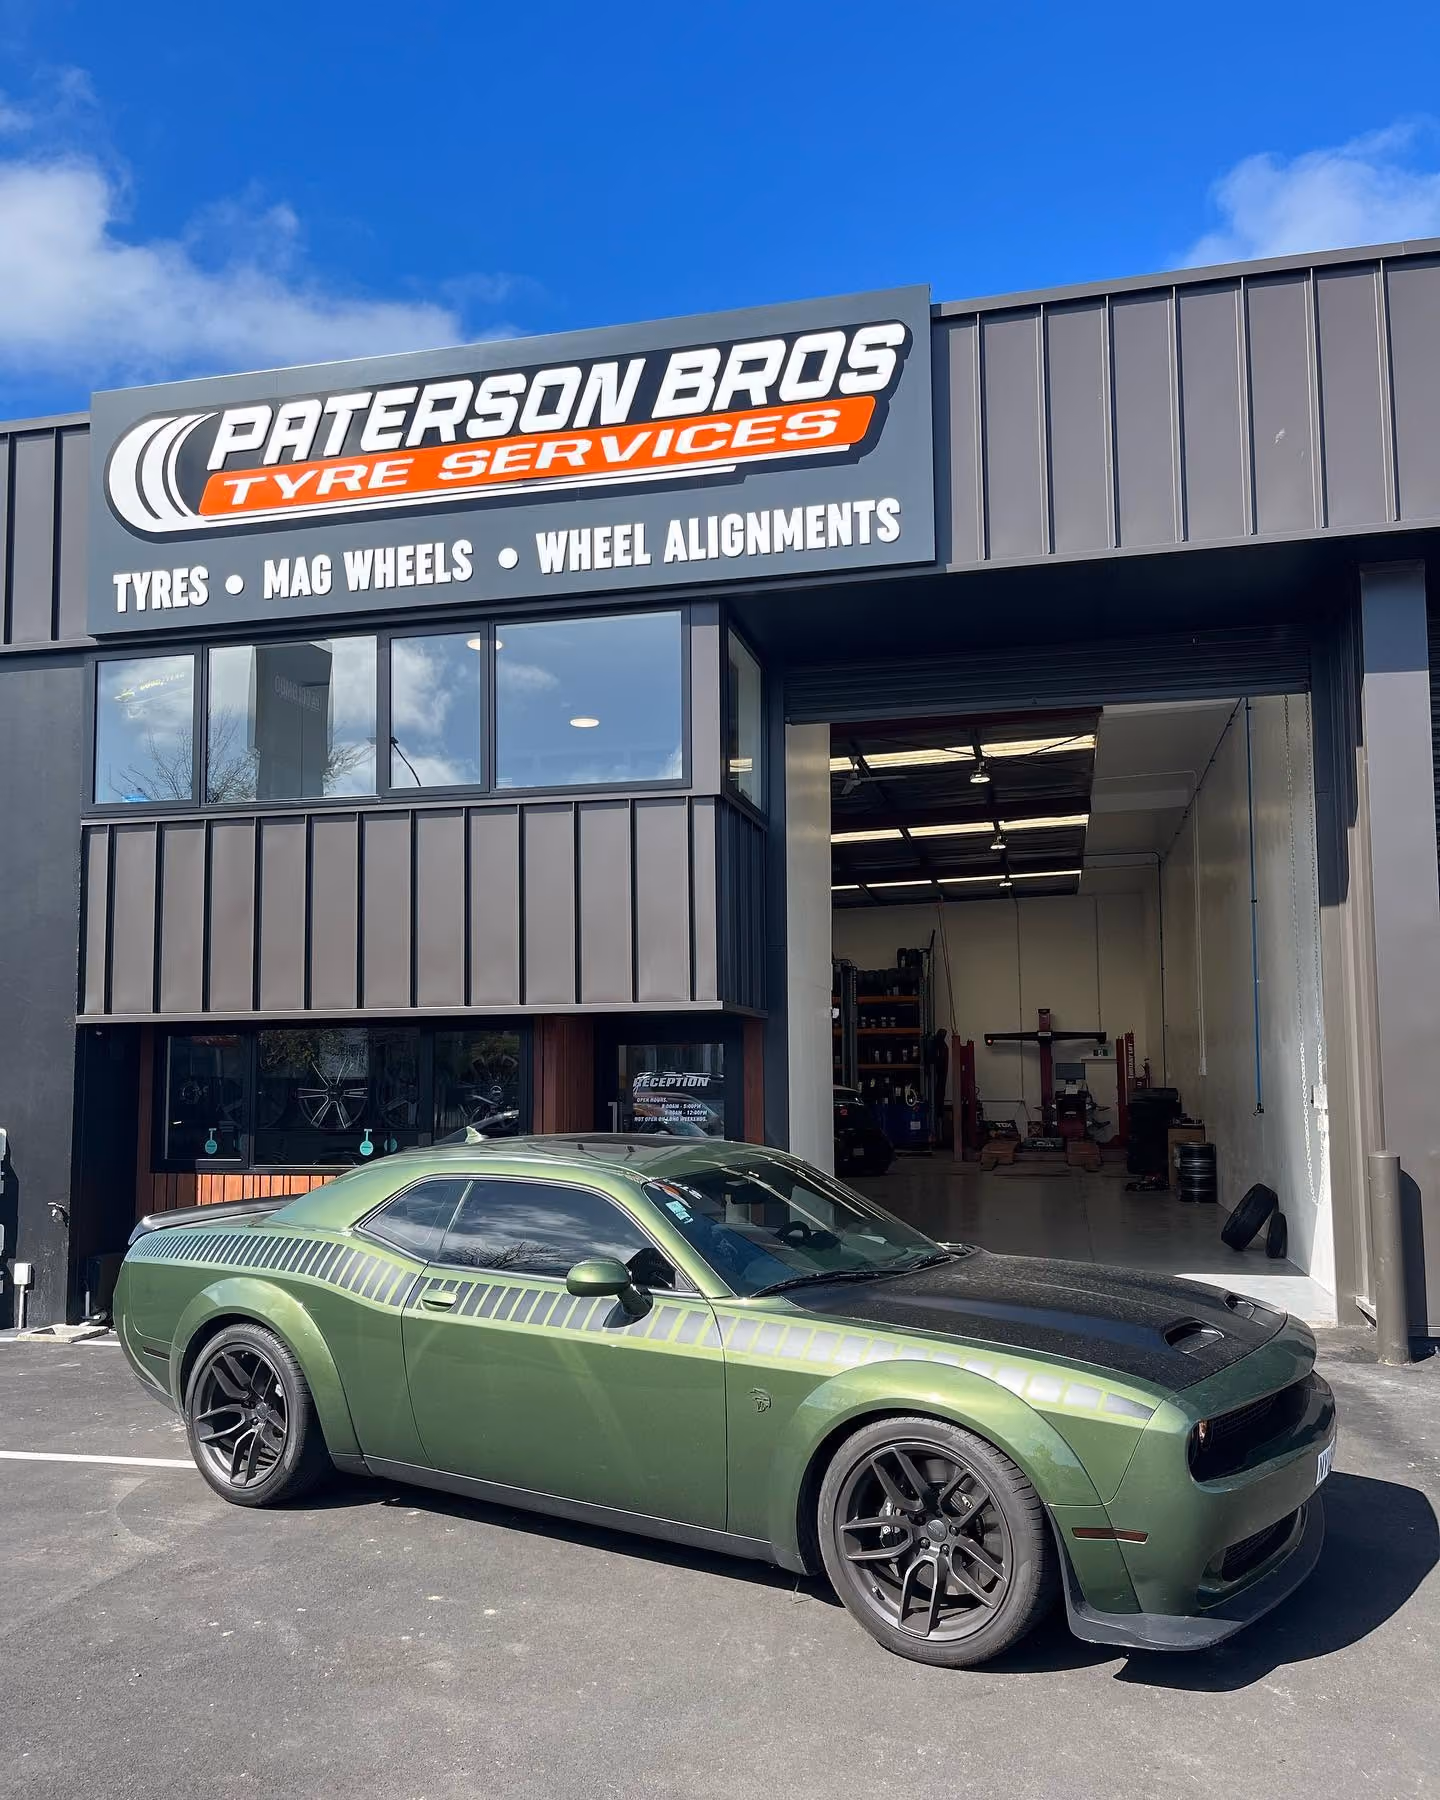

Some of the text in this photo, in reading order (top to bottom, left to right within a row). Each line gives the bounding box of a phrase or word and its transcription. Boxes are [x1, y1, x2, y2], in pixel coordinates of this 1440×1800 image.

[206, 323, 906, 471] PATERSON BROS
[223, 408, 841, 506] TYRE SERVICES
[112, 497, 901, 613] TYRES MAG WHEELS WHEEL ALIGNMENTS
[632, 1076, 709, 1088] RECEPTION
